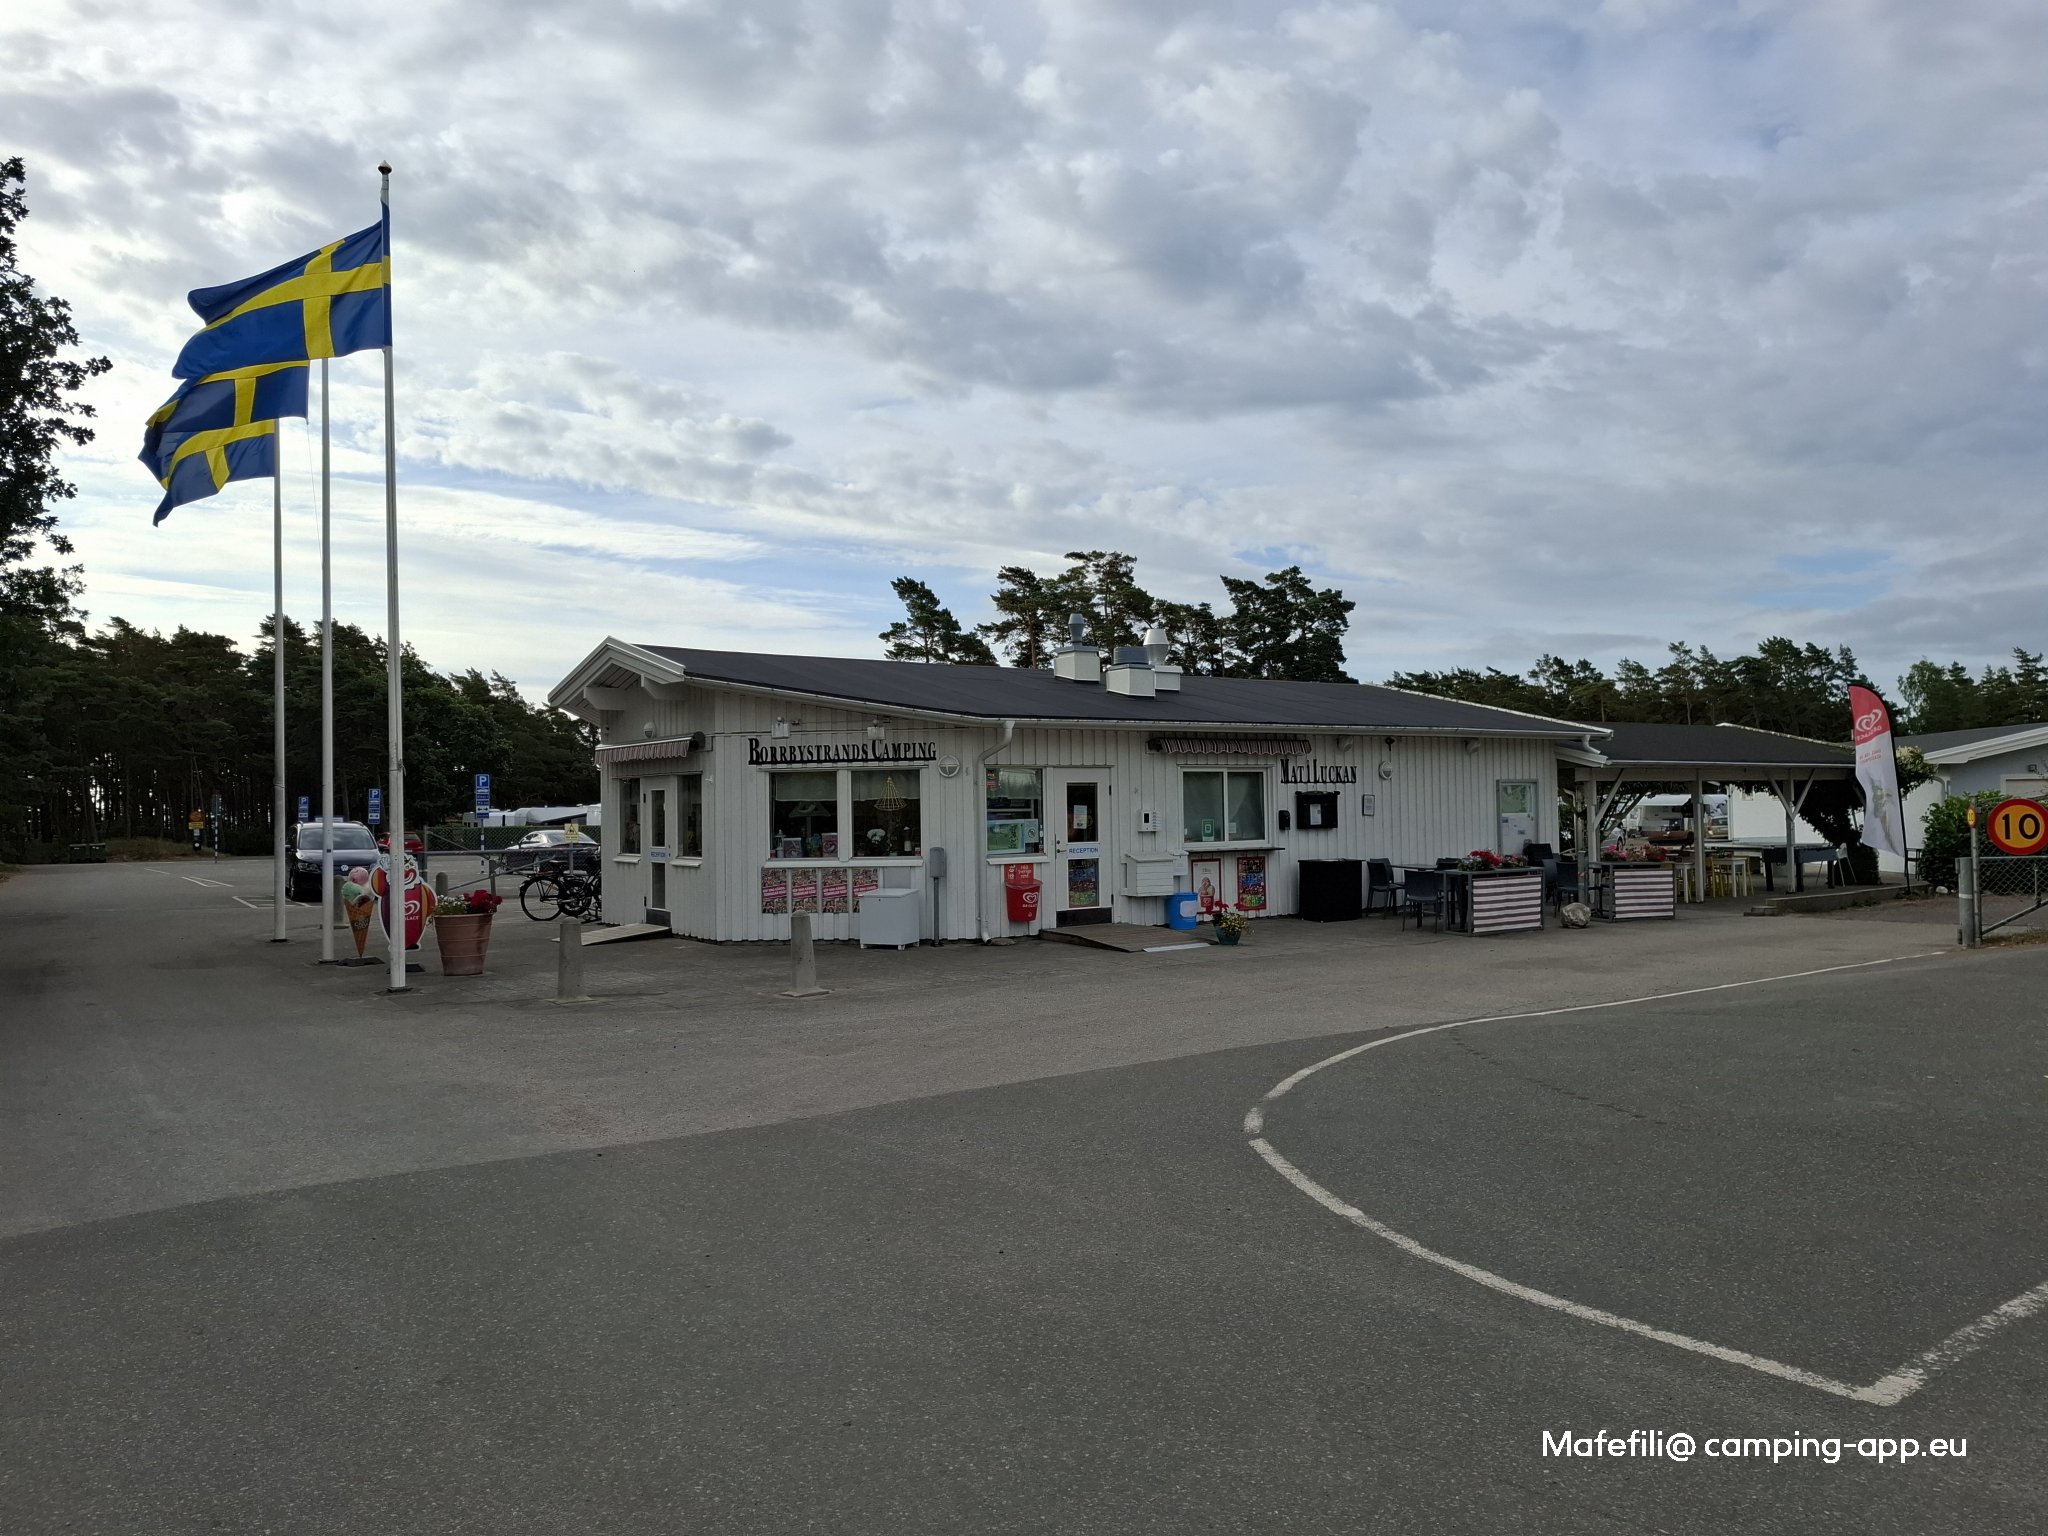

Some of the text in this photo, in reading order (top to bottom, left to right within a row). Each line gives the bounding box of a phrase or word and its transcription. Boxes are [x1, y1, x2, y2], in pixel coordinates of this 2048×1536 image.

[748, 738, 936, 765] BORRBYSTRANDS CAMPING
[479, 776, 487, 786] P
[1280, 759, 1305, 783] MAT
[1312, 759, 1357, 783] LUCKAN
[2002, 813, 2041, 840] 10
